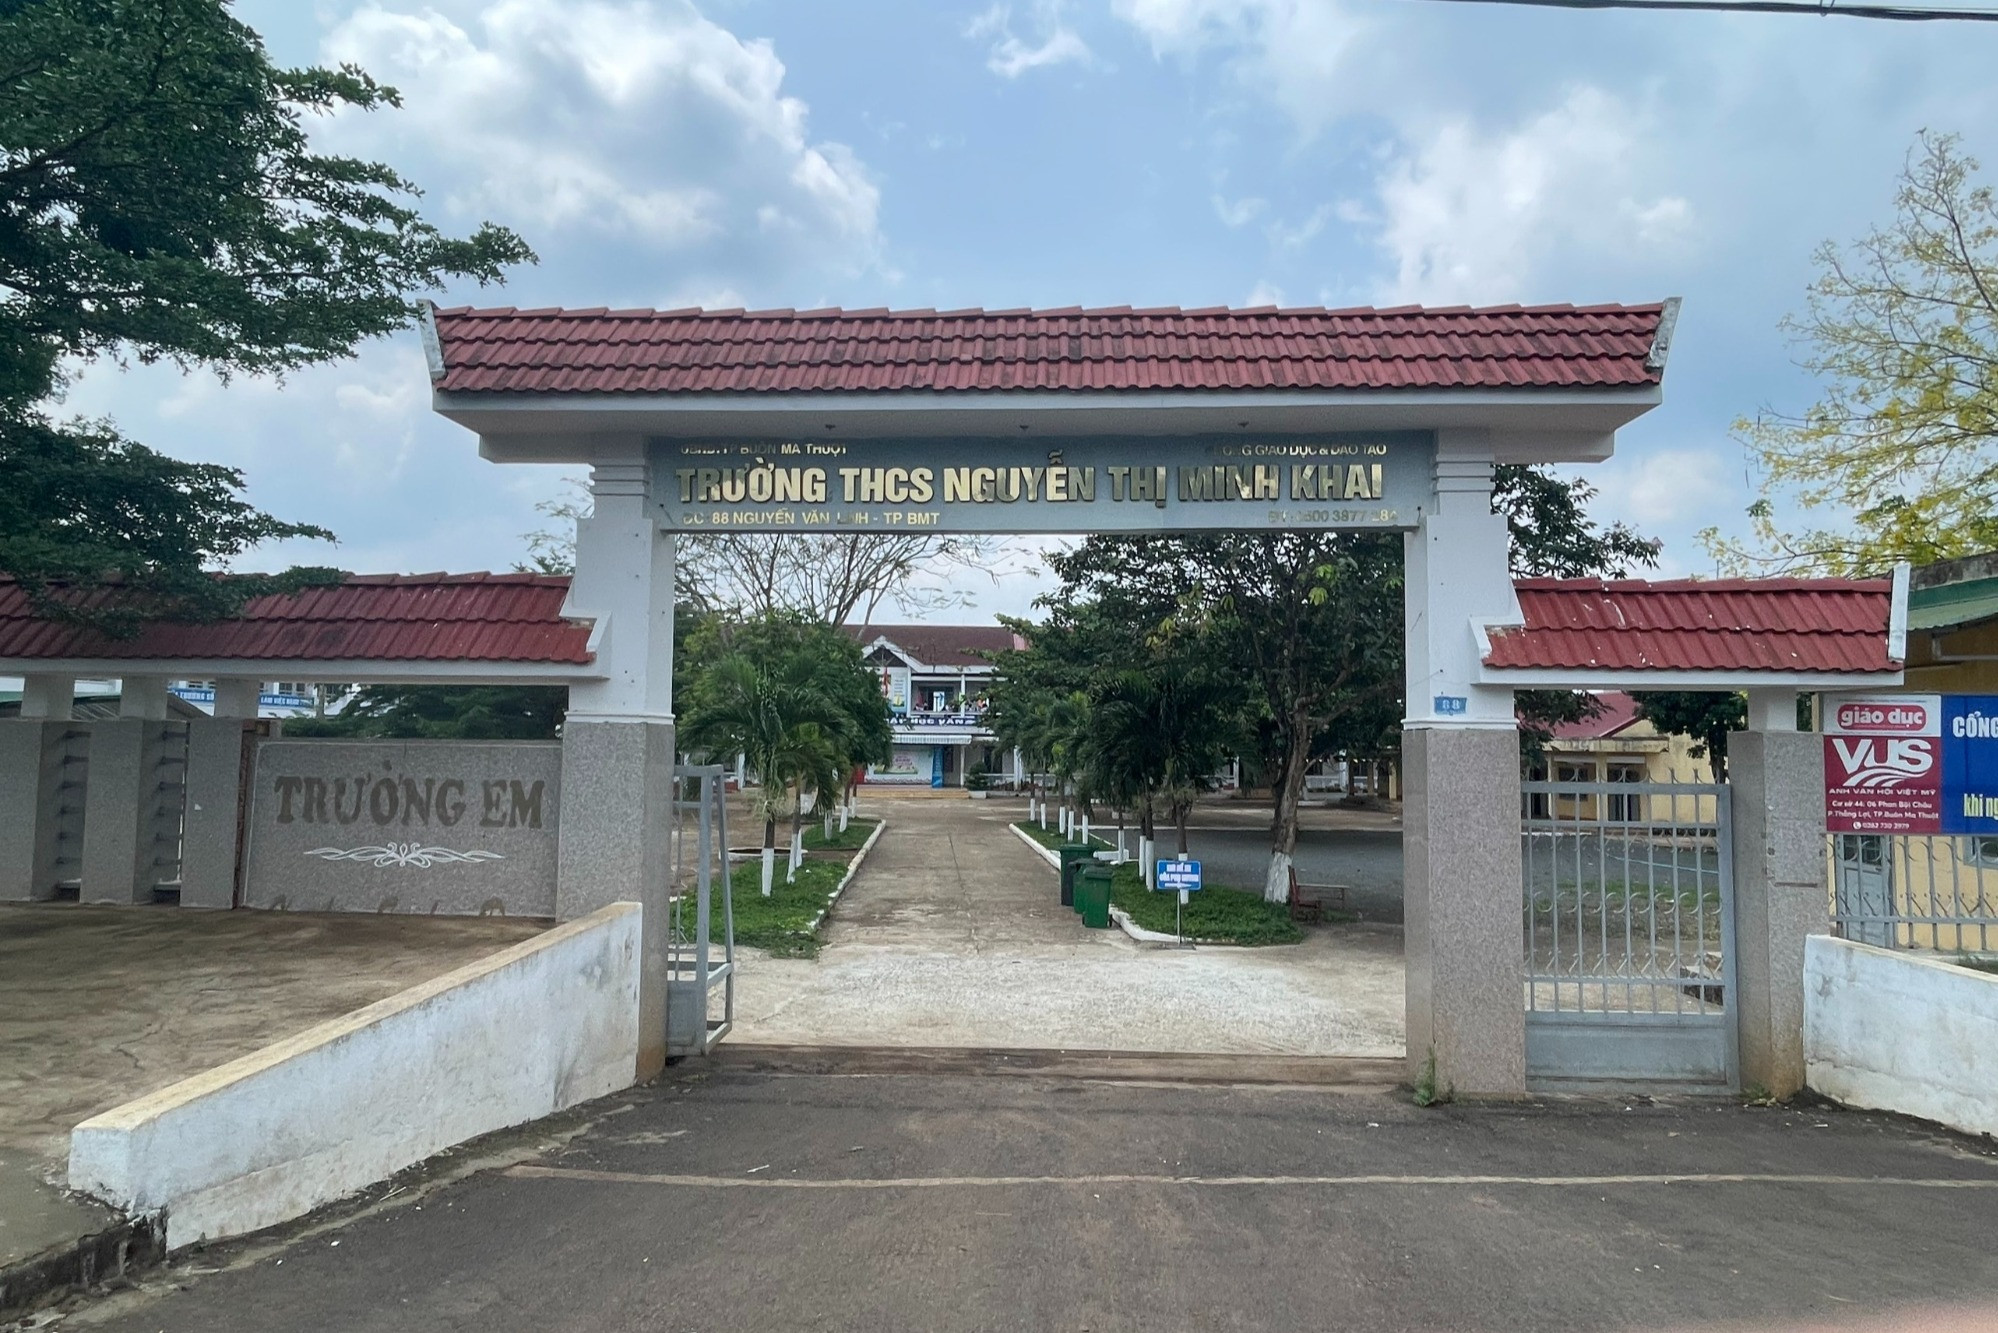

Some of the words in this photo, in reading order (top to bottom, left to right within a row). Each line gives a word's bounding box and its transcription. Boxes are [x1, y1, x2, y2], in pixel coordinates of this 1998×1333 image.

[780, 443, 801, 455] MA
[1363, 443, 1387, 458] TẠO
[676, 457, 827, 503] TRƯỜNG
[839, 467, 934, 503] THCS
[943, 450, 1096, 503] NGUYỄN
[1108, 466, 1167, 508] THỊ
[1179, 465, 1281, 501] MINH
[1291, 464, 1383, 500] KHAI
[712, 511, 730, 525] 88
[802, 508, 830, 525] VĂN
[884, 512, 903, 525] TP
[907, 511, 940, 525] BMT
[1840, 706, 1885, 727] giáo
[1888, 708, 1923, 728] dục
[1832, 739, 1933, 774] VUS
[274, 760, 467, 827] TRƯỜNG
[479, 779, 545, 829] EM
[1964, 793, 1984, 817] khi
